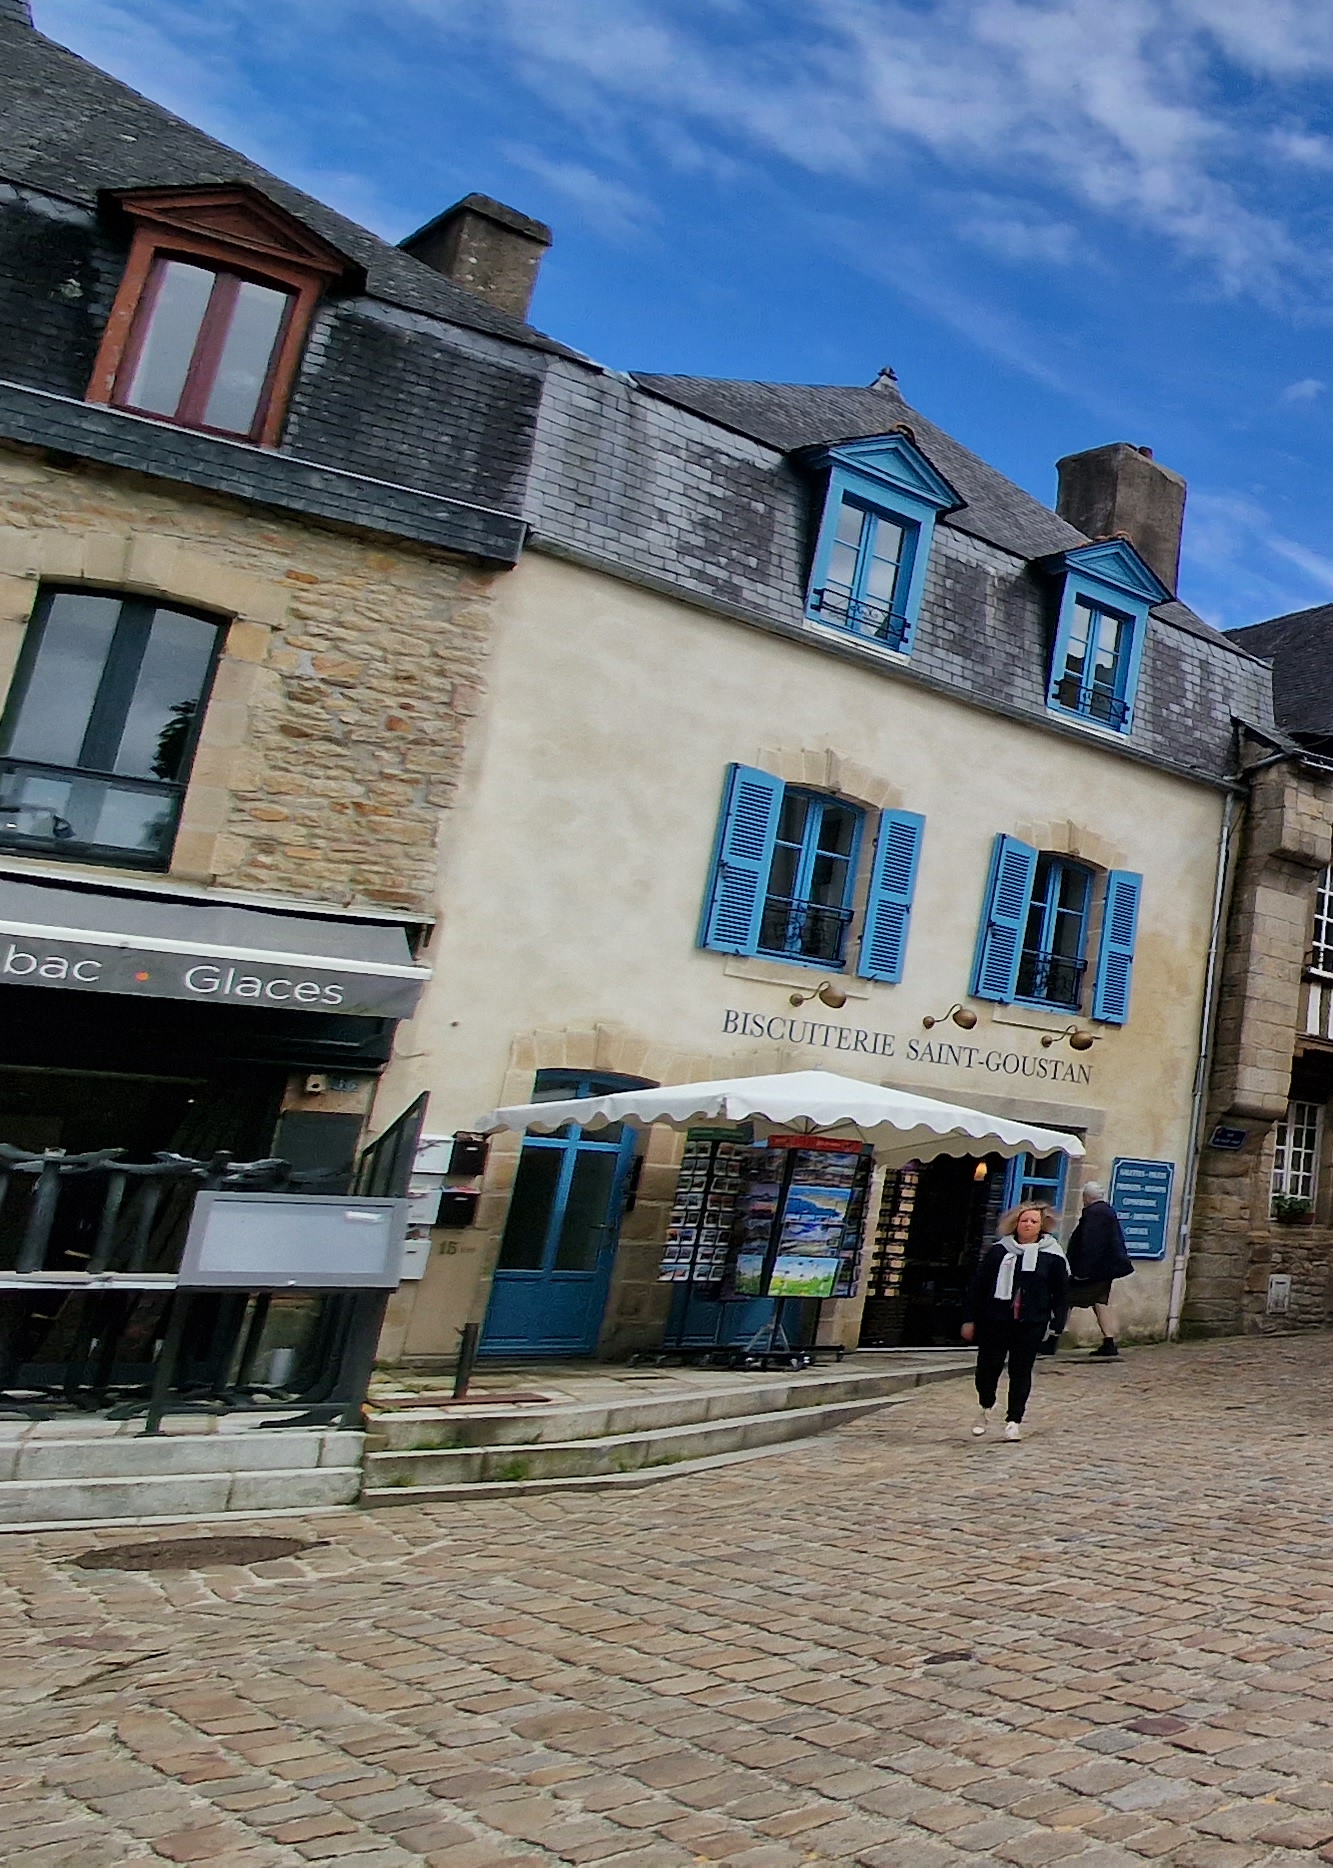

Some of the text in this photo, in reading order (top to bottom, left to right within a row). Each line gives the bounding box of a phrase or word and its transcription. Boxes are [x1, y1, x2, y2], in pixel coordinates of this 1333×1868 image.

[2, 944, 346, 1006] bac Glaces
[721, 1008, 1094, 1086] BISCUITERIE SAINT-GOUSTAN
